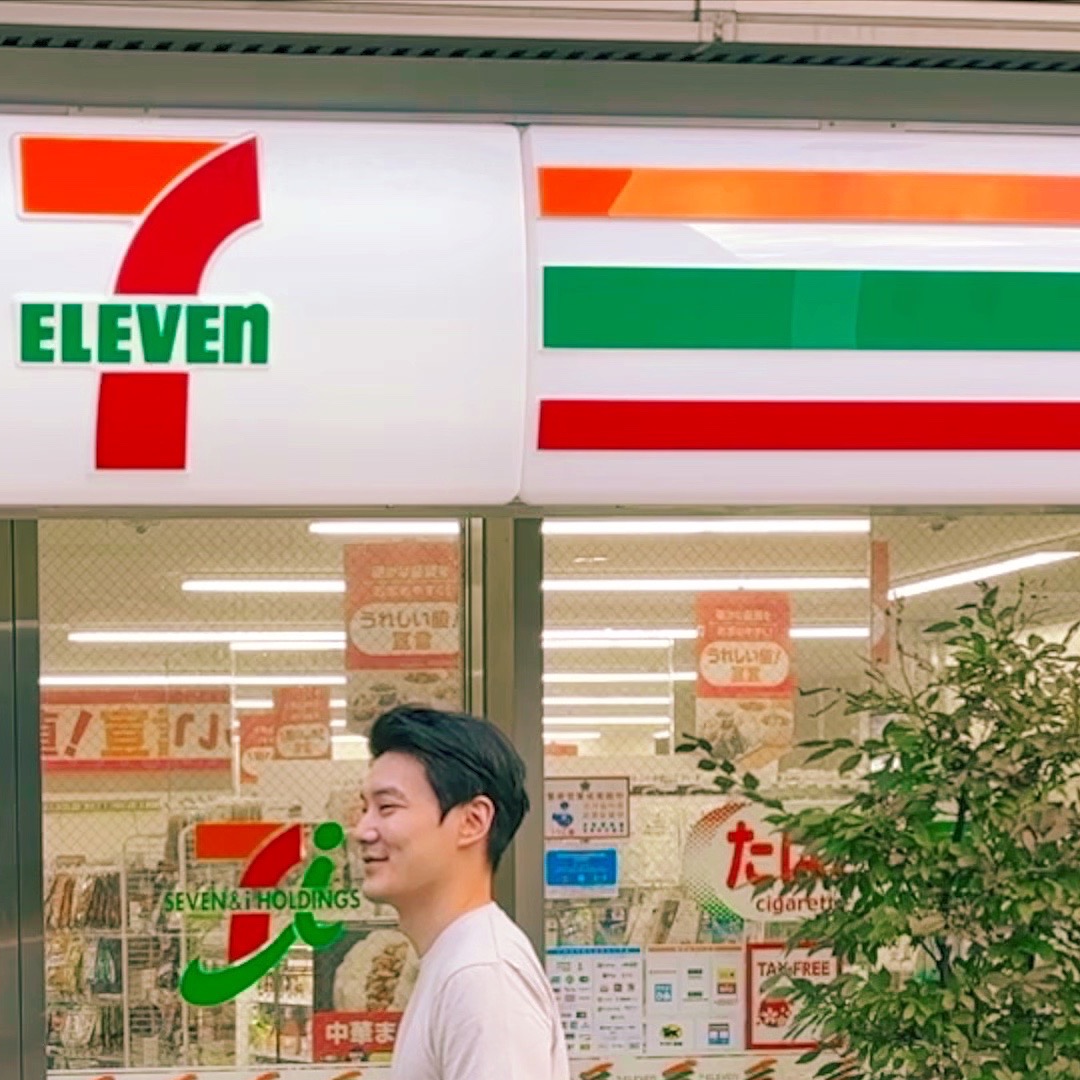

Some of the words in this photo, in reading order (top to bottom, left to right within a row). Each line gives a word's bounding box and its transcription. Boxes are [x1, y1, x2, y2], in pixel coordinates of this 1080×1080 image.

[20, 135, 261, 470] 7
[256, 887, 361, 911] HOLDINGS
[755, 892, 833, 915] cigarett
[325, 1021, 397, 1046] 中華ま
